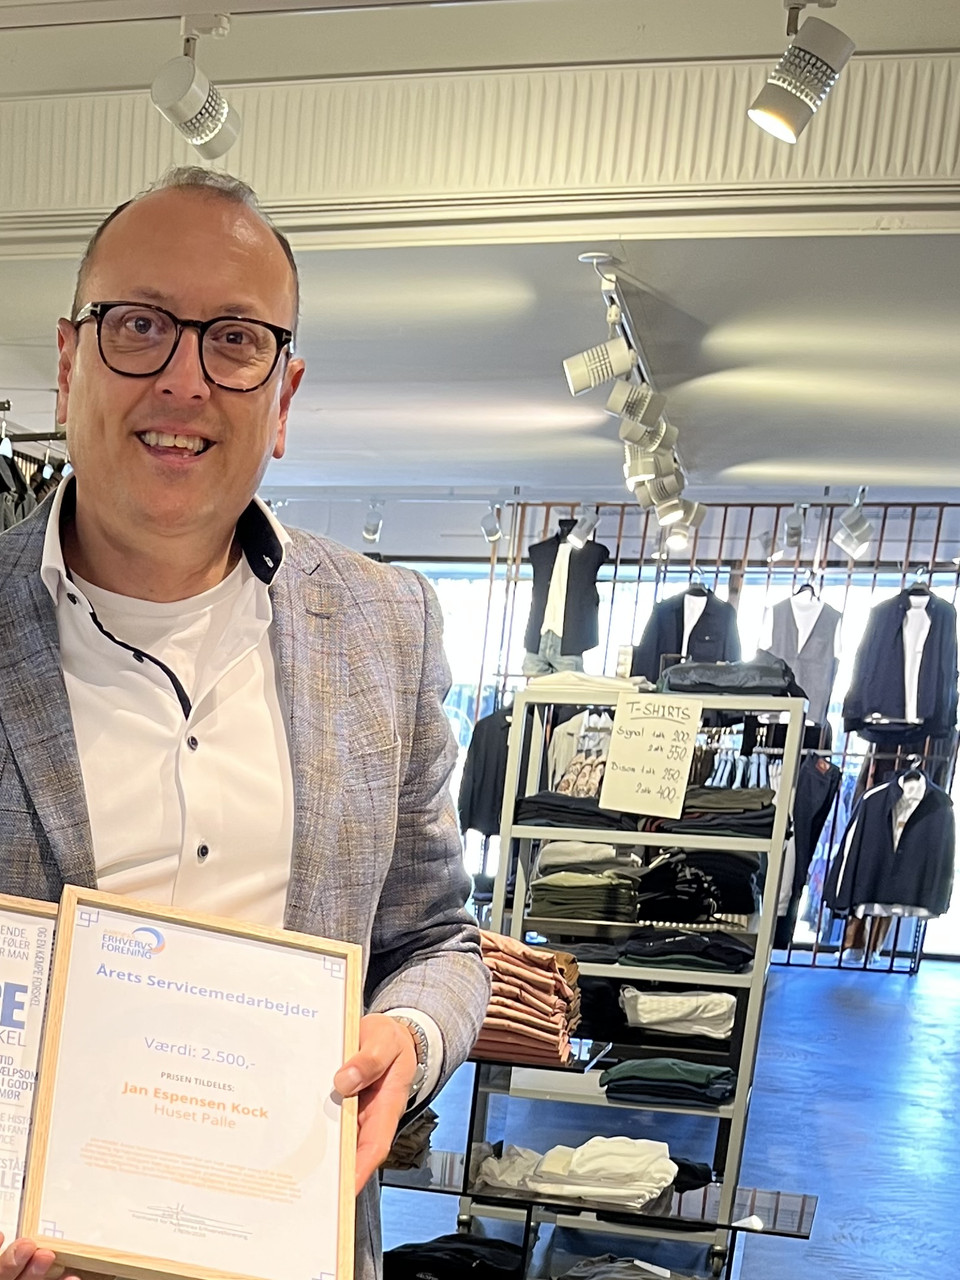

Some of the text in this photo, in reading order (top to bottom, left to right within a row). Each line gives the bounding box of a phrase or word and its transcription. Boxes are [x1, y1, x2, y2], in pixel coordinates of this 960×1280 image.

[626, 701, 691, 720] T-SHIRTS
[3, 937, 31, 950] FØLER
[101, 942, 152, 960] FORENING
[102, 933, 153, 951] ERHVERVS
[7, 948, 30, 961] MAN
[96, 962, 319, 1019] Årets Servicemedarbejder
[144, 1036, 256, 1070] Værdi: 2.500,-
[7, 1079, 35, 1092] GODT
[160, 1071, 235, 1092] PRISEN TILDELES:
[121, 1081, 270, 1120] Jan Espensen Kock
[153, 1103, 237, 1130] Huset Palle
